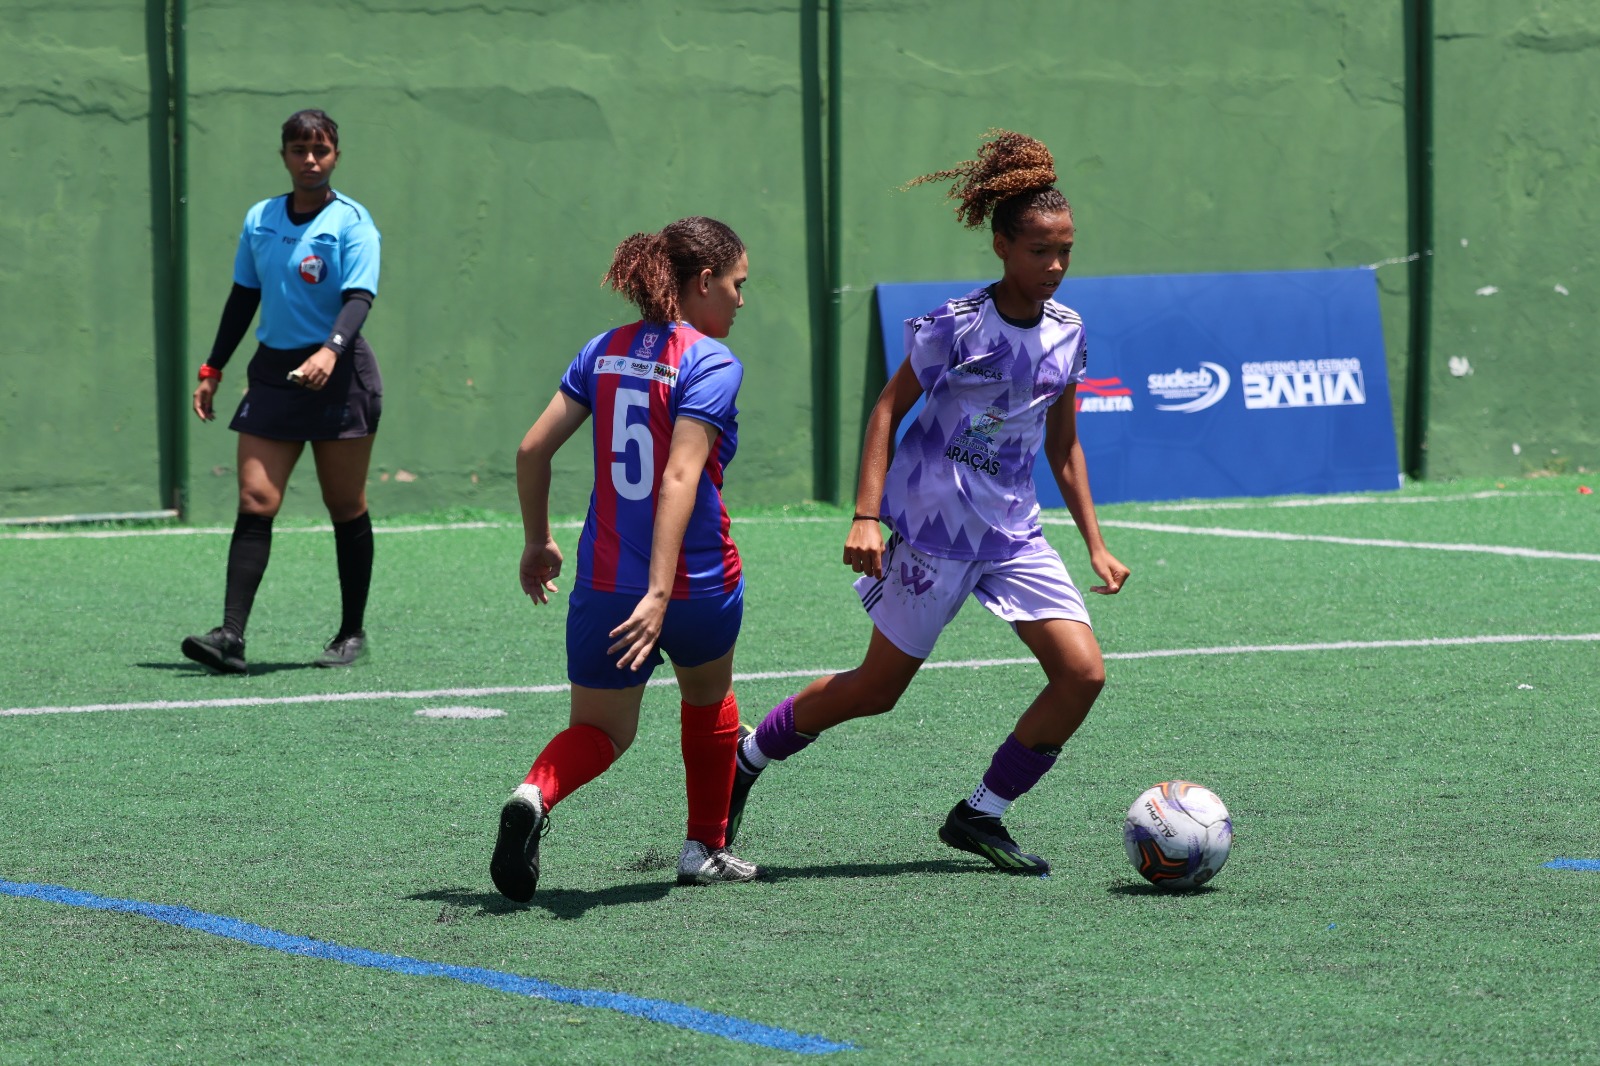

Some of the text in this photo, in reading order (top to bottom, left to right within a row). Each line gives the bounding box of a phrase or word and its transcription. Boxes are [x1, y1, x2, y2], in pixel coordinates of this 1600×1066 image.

[1147, 367, 1213, 389] sudesb
[1242, 357, 1361, 375] GOVERNO DO ESTADO
[1242, 371, 1366, 409] BAHIA
[611, 387, 655, 501] 5
[944, 444, 1001, 476] ARAÇÁS
[1144, 800, 1175, 839] ALLPHA
